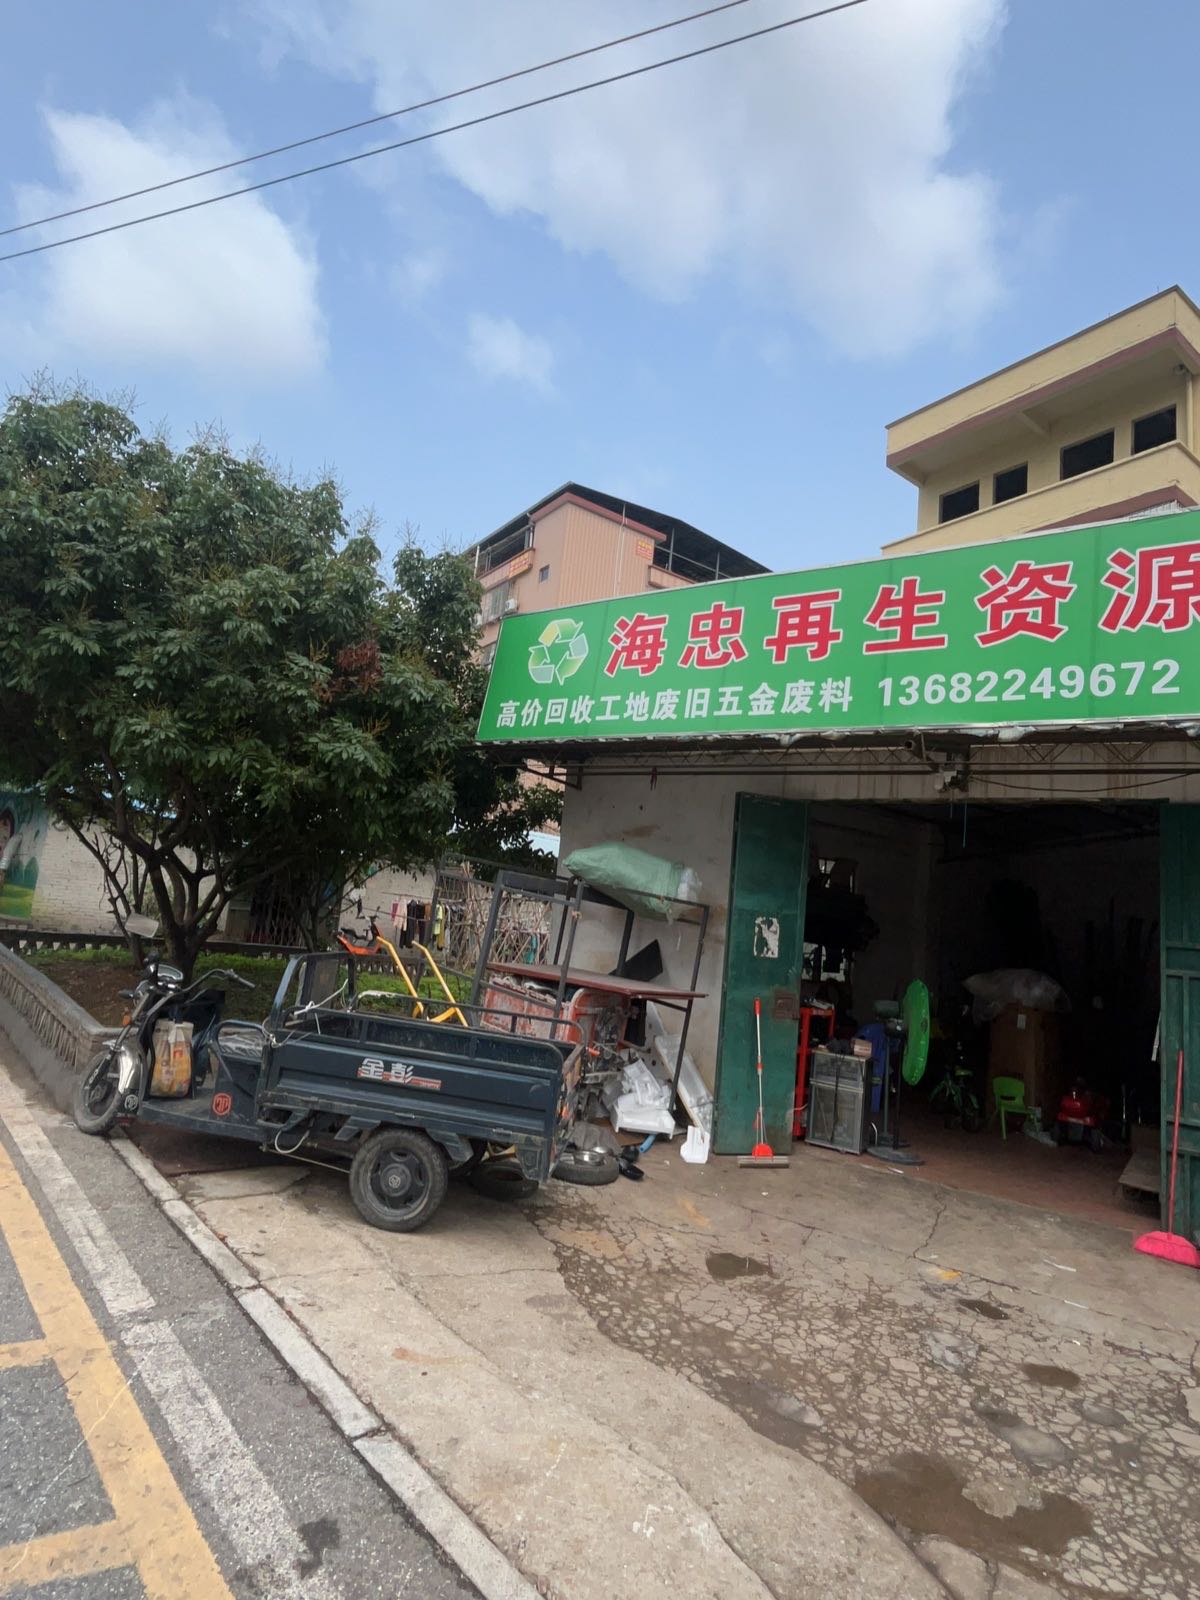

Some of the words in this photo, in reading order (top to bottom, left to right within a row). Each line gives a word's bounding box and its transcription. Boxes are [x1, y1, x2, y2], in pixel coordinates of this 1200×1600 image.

[603, 541, 1200, 678] 海忠再生资源
[496, 676, 853, 728] 高价回收工地废旧五金废料
[877, 659, 1180, 707] 13682249672
[359, 1058, 414, 1084] 金彭
